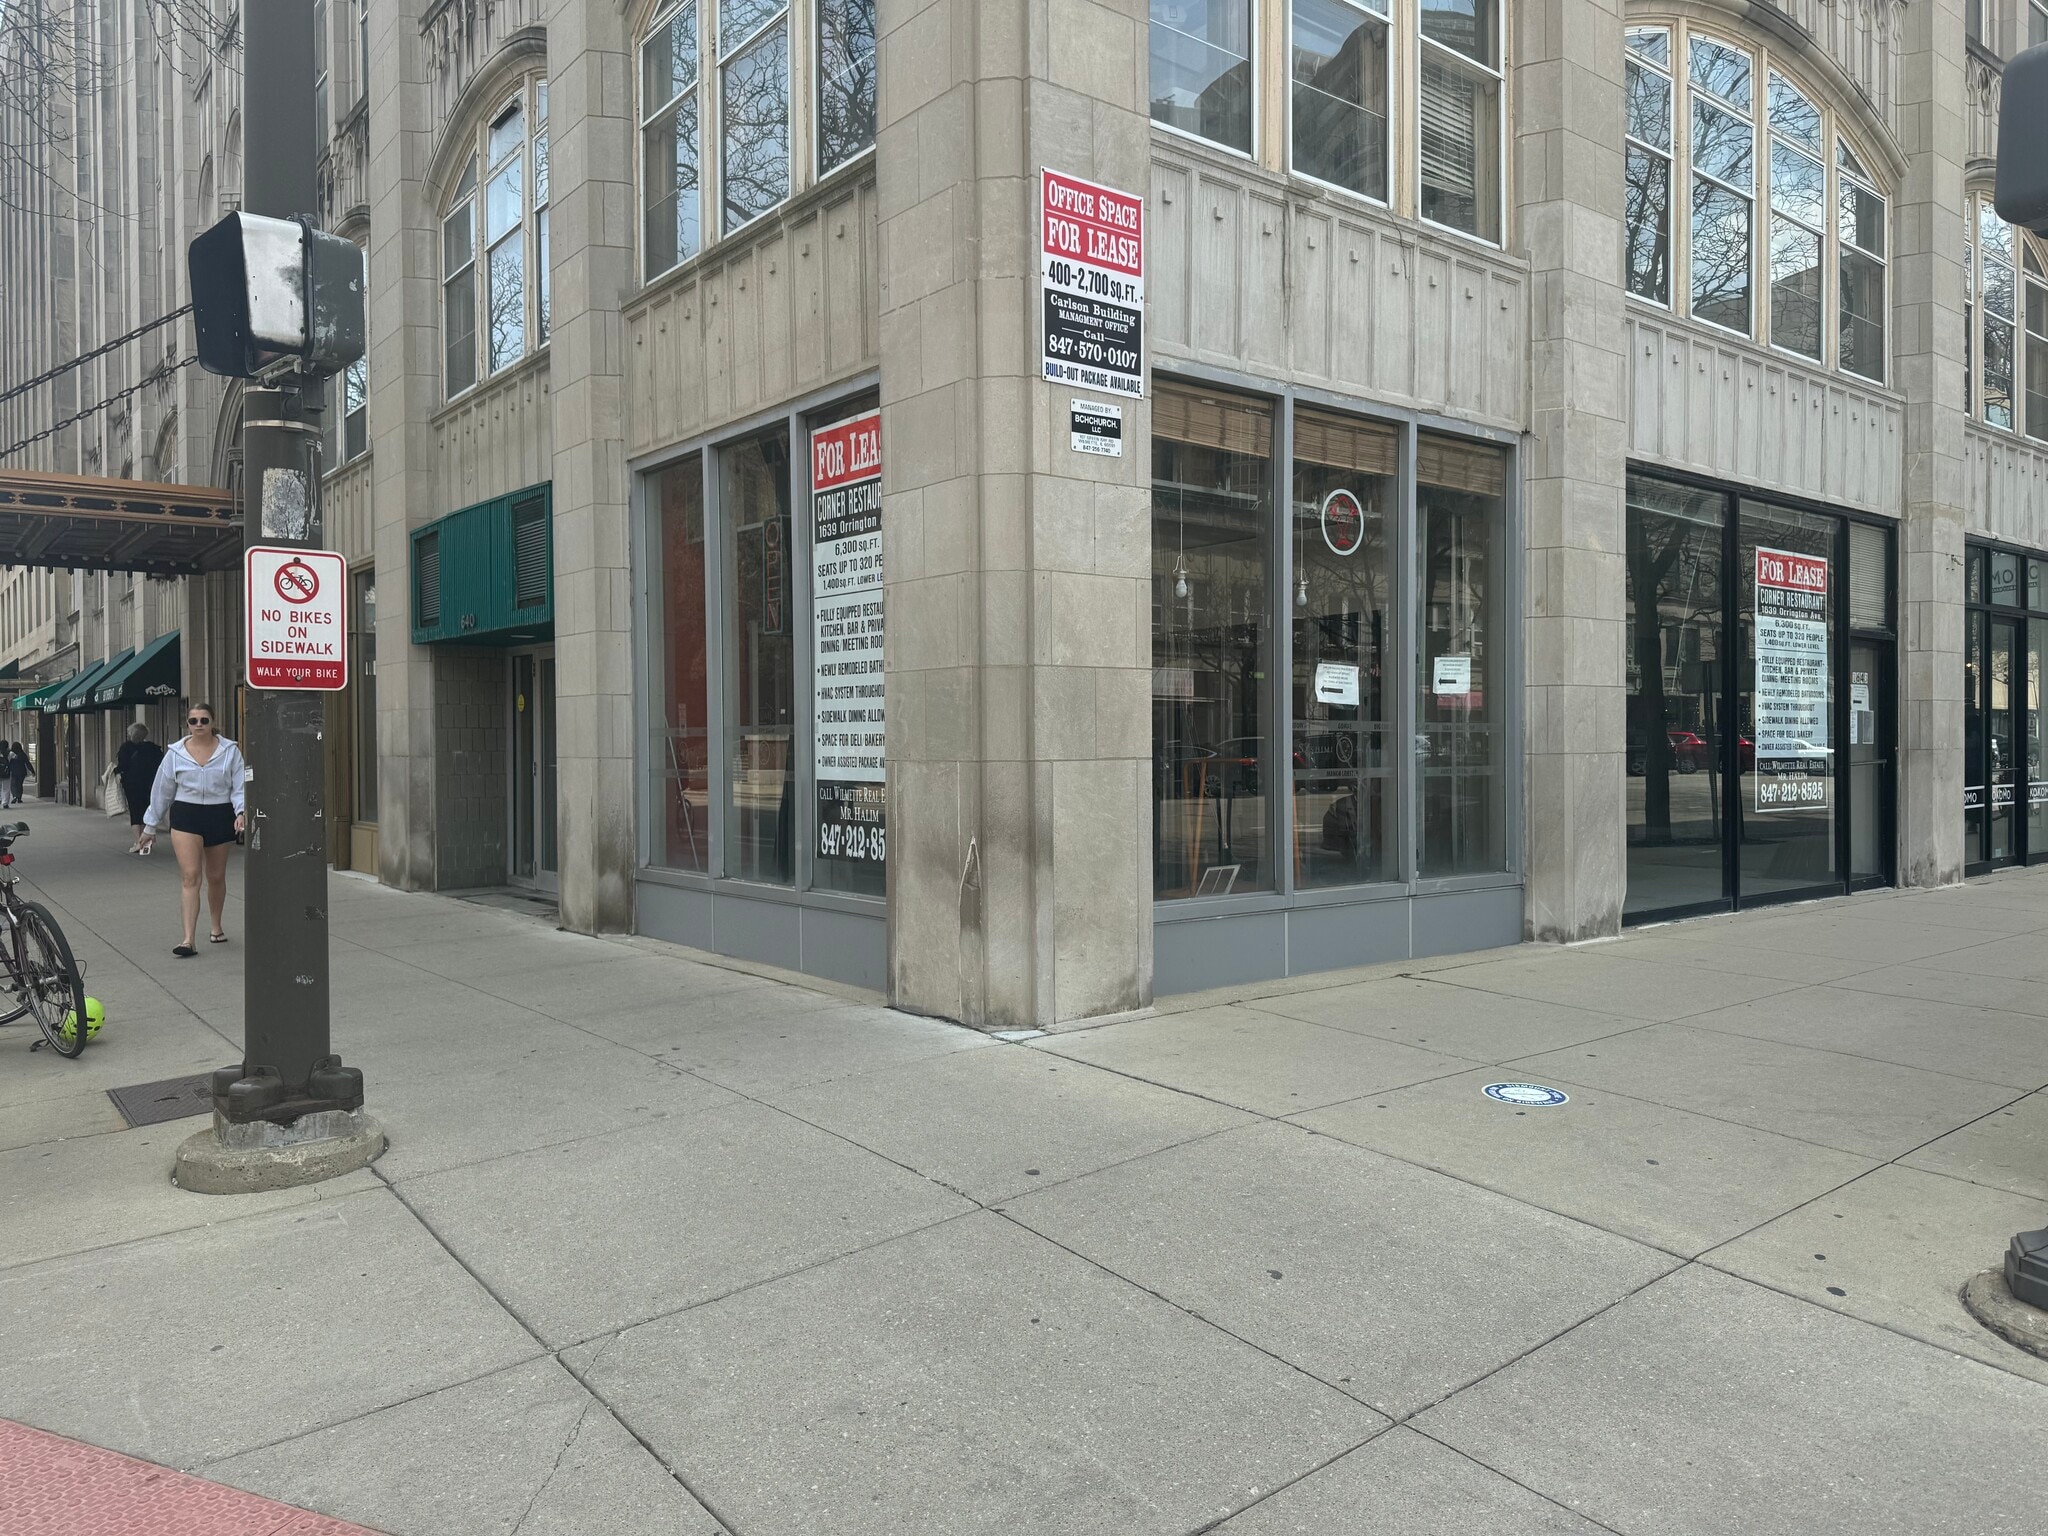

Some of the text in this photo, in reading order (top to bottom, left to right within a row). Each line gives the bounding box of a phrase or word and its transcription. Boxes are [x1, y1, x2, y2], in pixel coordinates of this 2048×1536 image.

[1048, 180, 1137, 230] OFFICE SPACE
[1047, 217, 1138, 269] FOR LEASE
[1048, 261, 1108, 296] 400-2,700
[1051, 294, 1135, 327] Carlson Building
[1059, 309, 1128, 334] MANAGMENT OFFICE
[1083, 330, 1104, 342] Call
[1045, 362, 1141, 394] BUILD-OUT PACKAGE AVAILABLE
[1080, 403, 1104, 413] MANAGED
[817, 430, 881, 481] FOR LEA
[817, 491, 845, 522] CORNER
[819, 516, 877, 538] 1639 Orrington
[835, 540, 857, 556] 6,300
[818, 562, 837, 577] SEATS
[839, 560, 848, 574] UP
[849, 559, 858, 573] TO
[860, 556, 872, 571] 320
[1760, 557, 1824, 587] FOR LEASE
[766, 521, 781, 631] OPEN
[857, 574, 875, 585] LOWER
[1760, 588, 1824, 611] CORNER RESTAURANT
[261, 609, 332, 625] NO BIKES
[820, 608, 835, 622] FULLY
[836, 604, 862, 621] EQUIPPED
[1761, 605, 1776, 615] 1639
[1779, 608, 1808, 619] Orrington
[460, 613, 475, 629] 640
[847, 621, 859, 635] BAR
[861, 620, 866, 633] &
[288, 626, 307, 639] ON
[1760, 629, 1777, 638] SEATS
[1787, 631, 1794, 639] TO
[1795, 632, 1805, 640] 320
[1806, 633, 1824, 642] PEOPLE
[261, 640, 333, 655] SIDEWALK
[257, 666, 338, 678] WALK YOUR BIKE
[820, 663, 836, 676] NEWLY
[838, 661, 868, 675] REMODELED
[820, 687, 833, 700] HVAC
[835, 685, 854, 699] SYSTEM
[822, 710, 847, 723] SIDEWALK
[849, 709, 866, 722] DINING
[821, 733, 837, 747] SPACE
[839, 733, 849, 746] FOR
[1761, 730, 1775, 738] SPACE
[821, 756, 836, 767] OWNER
[837, 756, 857, 768] ASSISTED
[858, 756, 878, 768] PACKAGE
[820, 787, 833, 800] CALL
[834, 785, 862, 802] WILMETTE
[863, 787, 879, 803] REAL
[854, 806, 879, 822] HALIM
